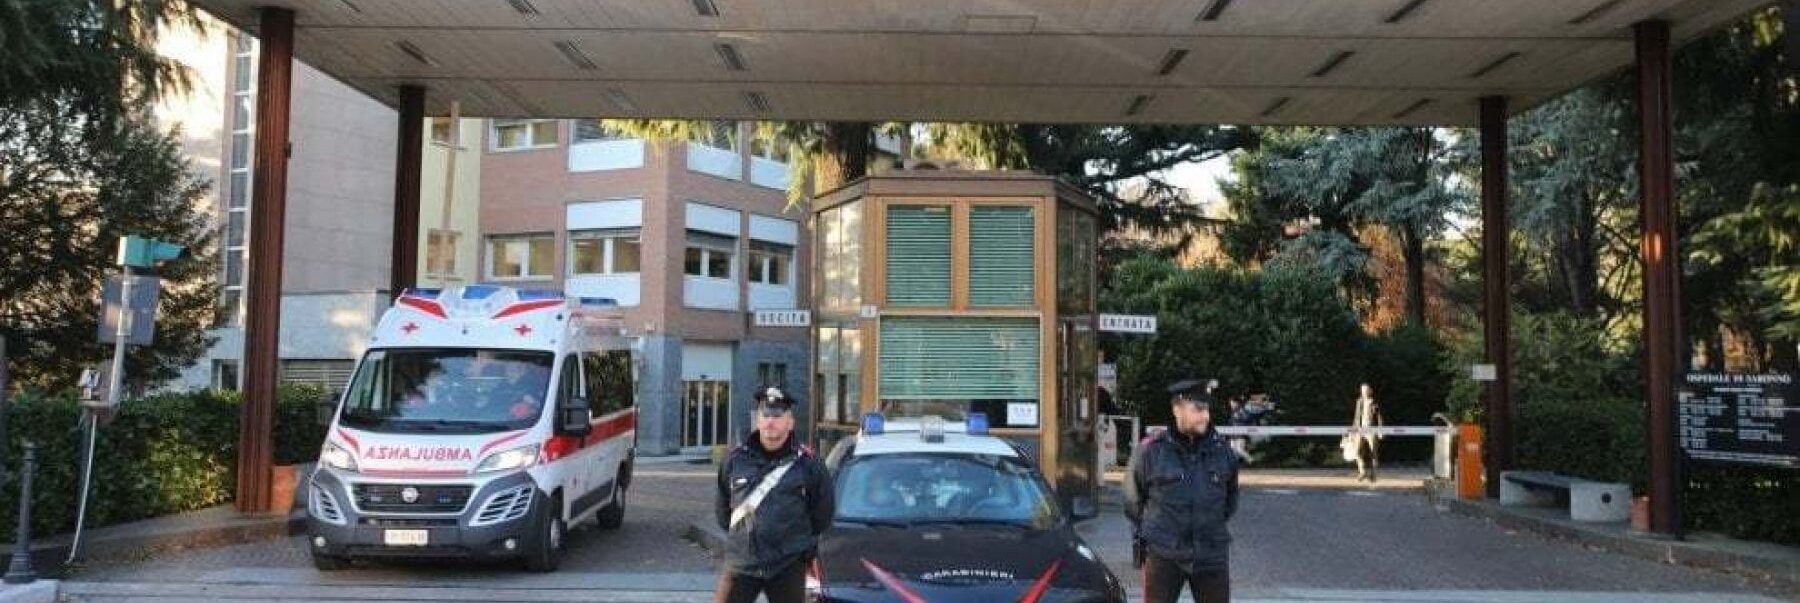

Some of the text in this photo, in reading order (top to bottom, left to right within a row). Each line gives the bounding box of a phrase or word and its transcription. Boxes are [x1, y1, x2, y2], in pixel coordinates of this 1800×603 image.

[759, 312, 806, 323] USCITA
[1103, 318, 1152, 329] ENTRATA
[920, 569, 1014, 580] CARABINIERI
